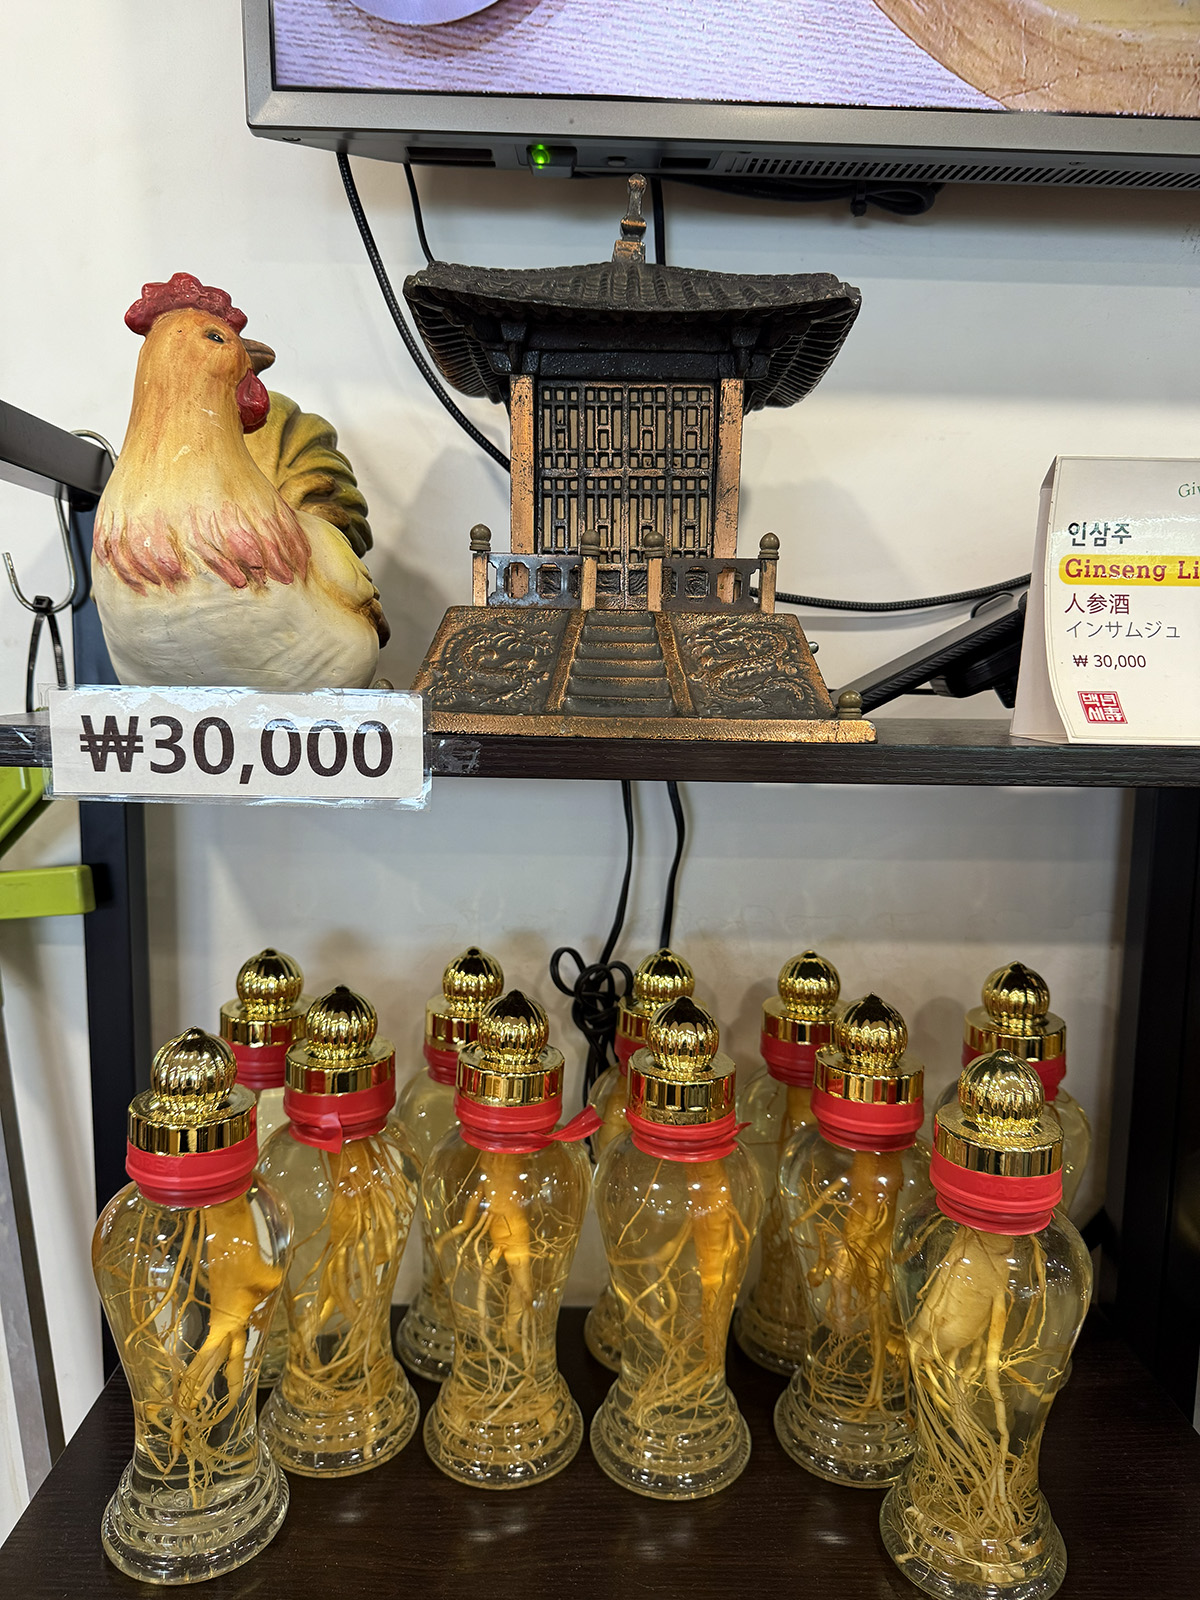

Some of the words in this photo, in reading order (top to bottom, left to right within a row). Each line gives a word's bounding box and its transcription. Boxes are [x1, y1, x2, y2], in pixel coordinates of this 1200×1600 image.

[1067, 521, 1132, 547] 인삼주
[1065, 558, 1167, 582] Ginseng
[1177, 560, 1200, 580] Li
[1064, 592, 1130, 615] 人参酒
[1066, 620, 1181, 639] インサムジュ
[1072, 654, 1089, 667] ₩
[1093, 654, 1147, 670] 30,000
[79, 714, 393, 785] ₩30,000
